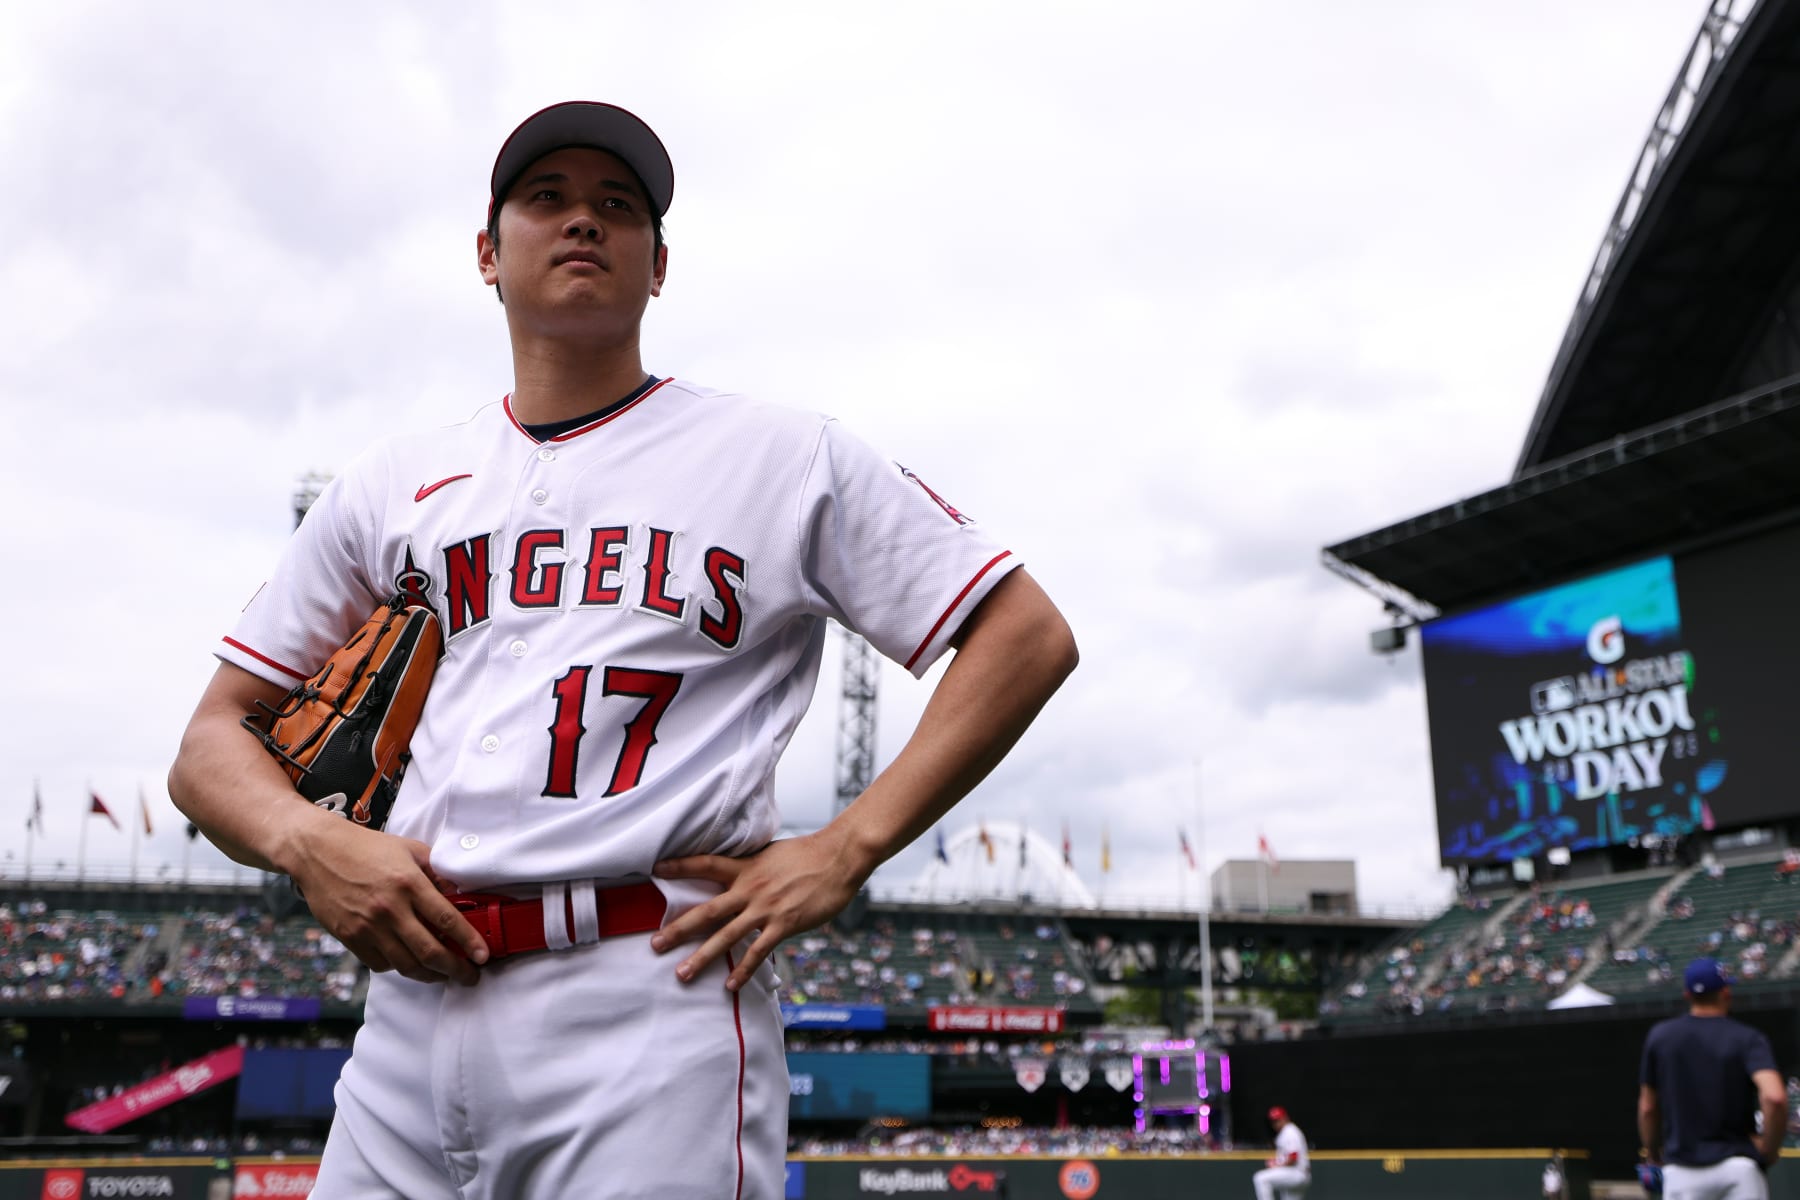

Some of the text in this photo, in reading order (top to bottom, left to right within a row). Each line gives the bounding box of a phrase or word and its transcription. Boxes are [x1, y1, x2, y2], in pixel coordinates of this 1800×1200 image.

[1586, 614, 1625, 664] G
[541, 665, 684, 799] 17
[1572, 737, 1668, 800] DAY
[87, 1175, 174, 1197] TOYOTA
[859, 1168, 949, 1195] KeyBank
